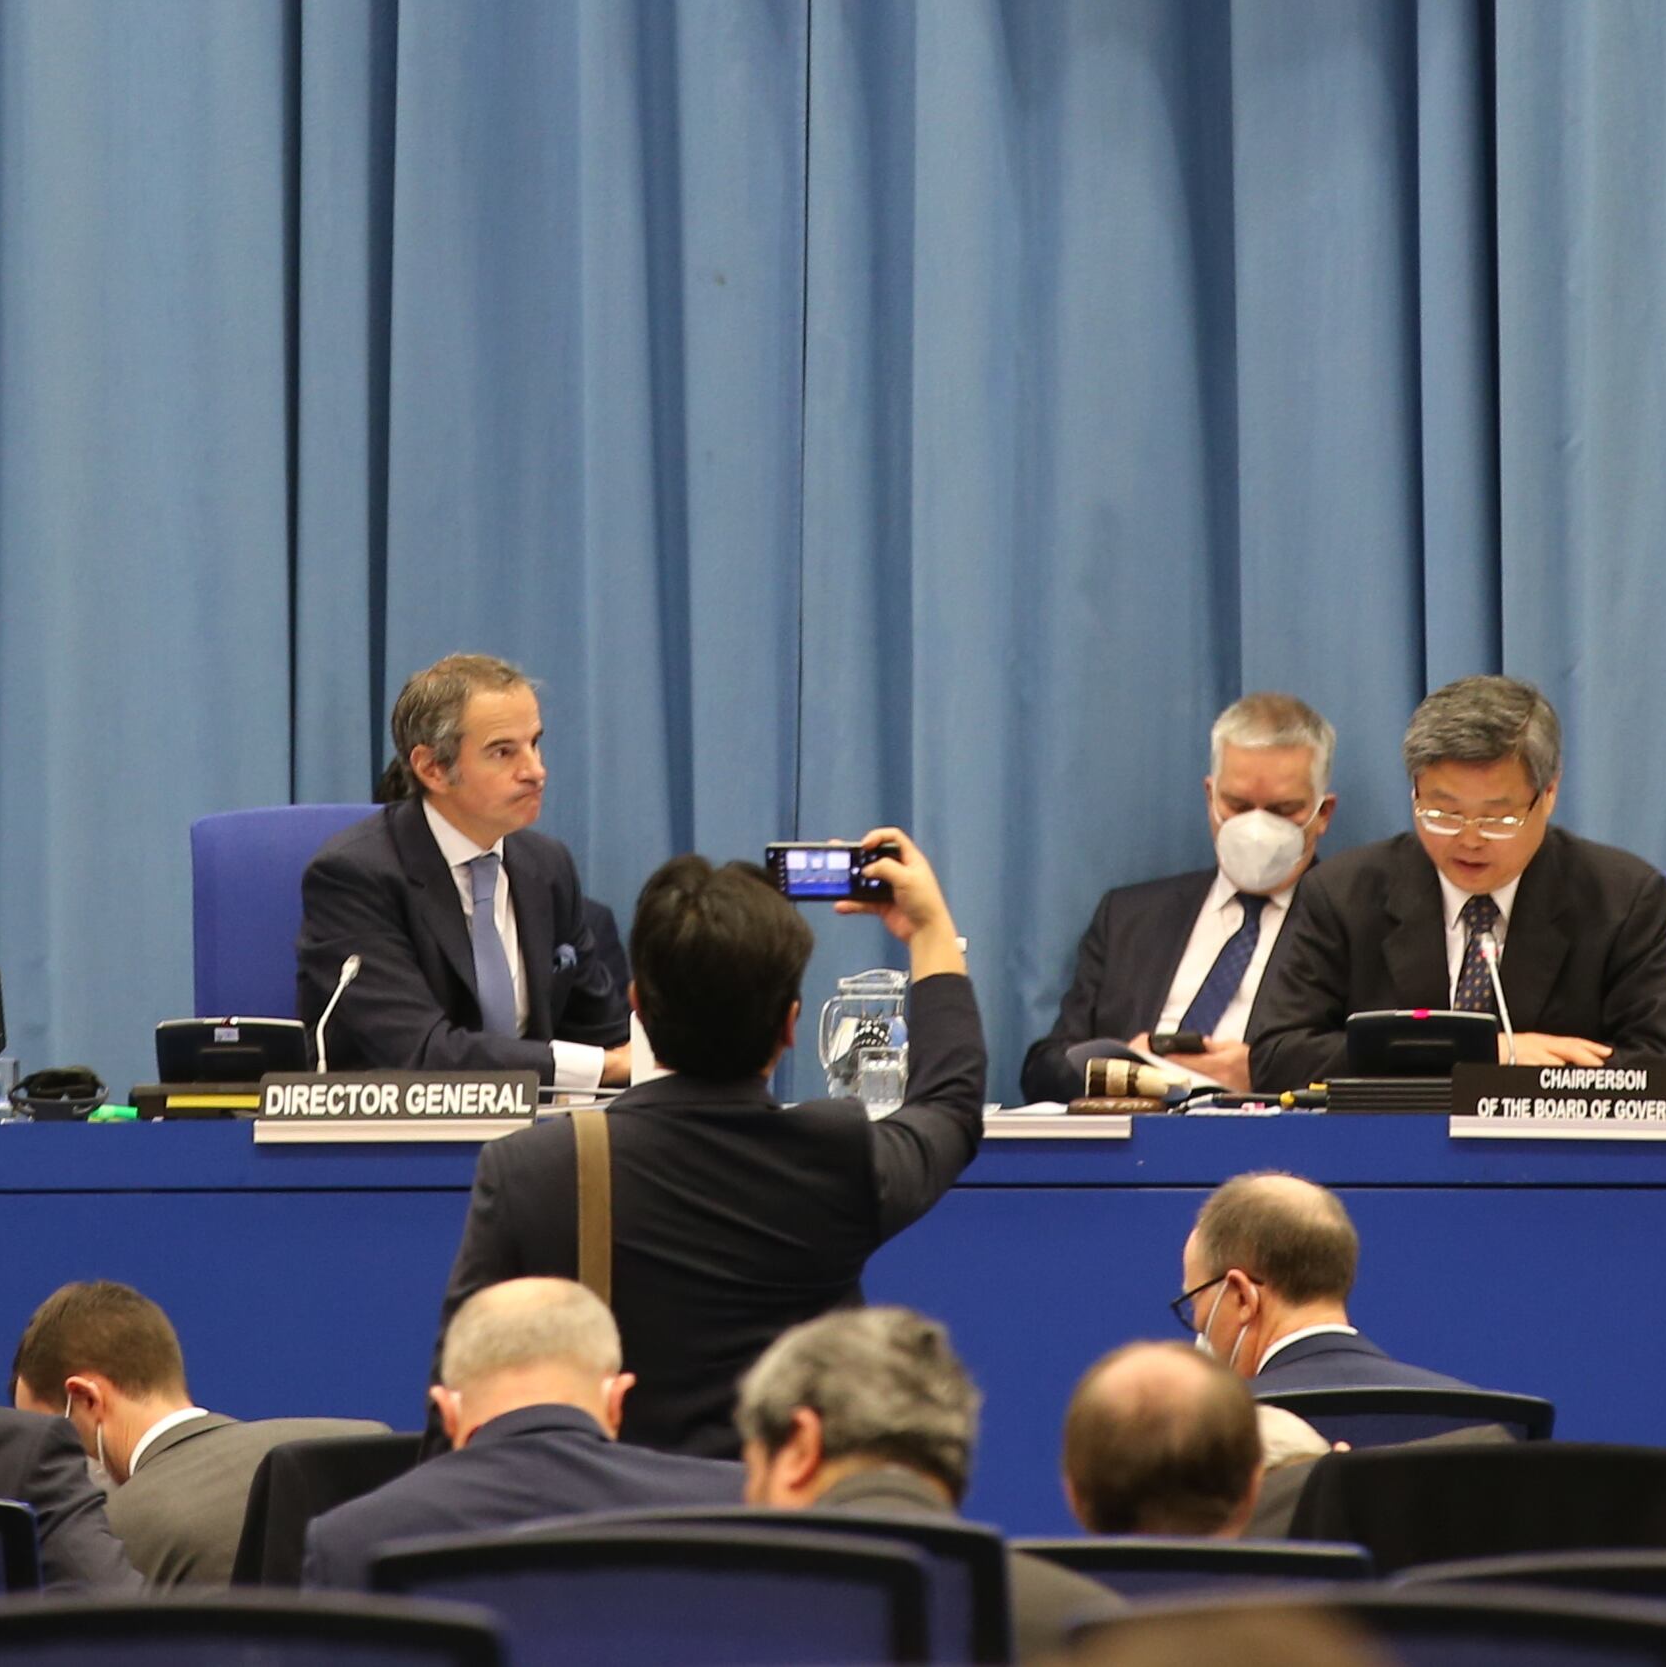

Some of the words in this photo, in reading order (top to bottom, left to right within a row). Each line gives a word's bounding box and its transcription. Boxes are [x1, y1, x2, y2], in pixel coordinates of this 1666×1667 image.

[1539, 1068, 1648, 1092] CHAIRPERSON
[264, 1083, 400, 1116] DIRECTOR
[404, 1082, 533, 1115] GENERAL
[1477, 1097, 1499, 1118] OF
[1501, 1098, 1531, 1119] THE
[1533, 1098, 1587, 1120] BOARD
[1590, 1099, 1612, 1120] OF
